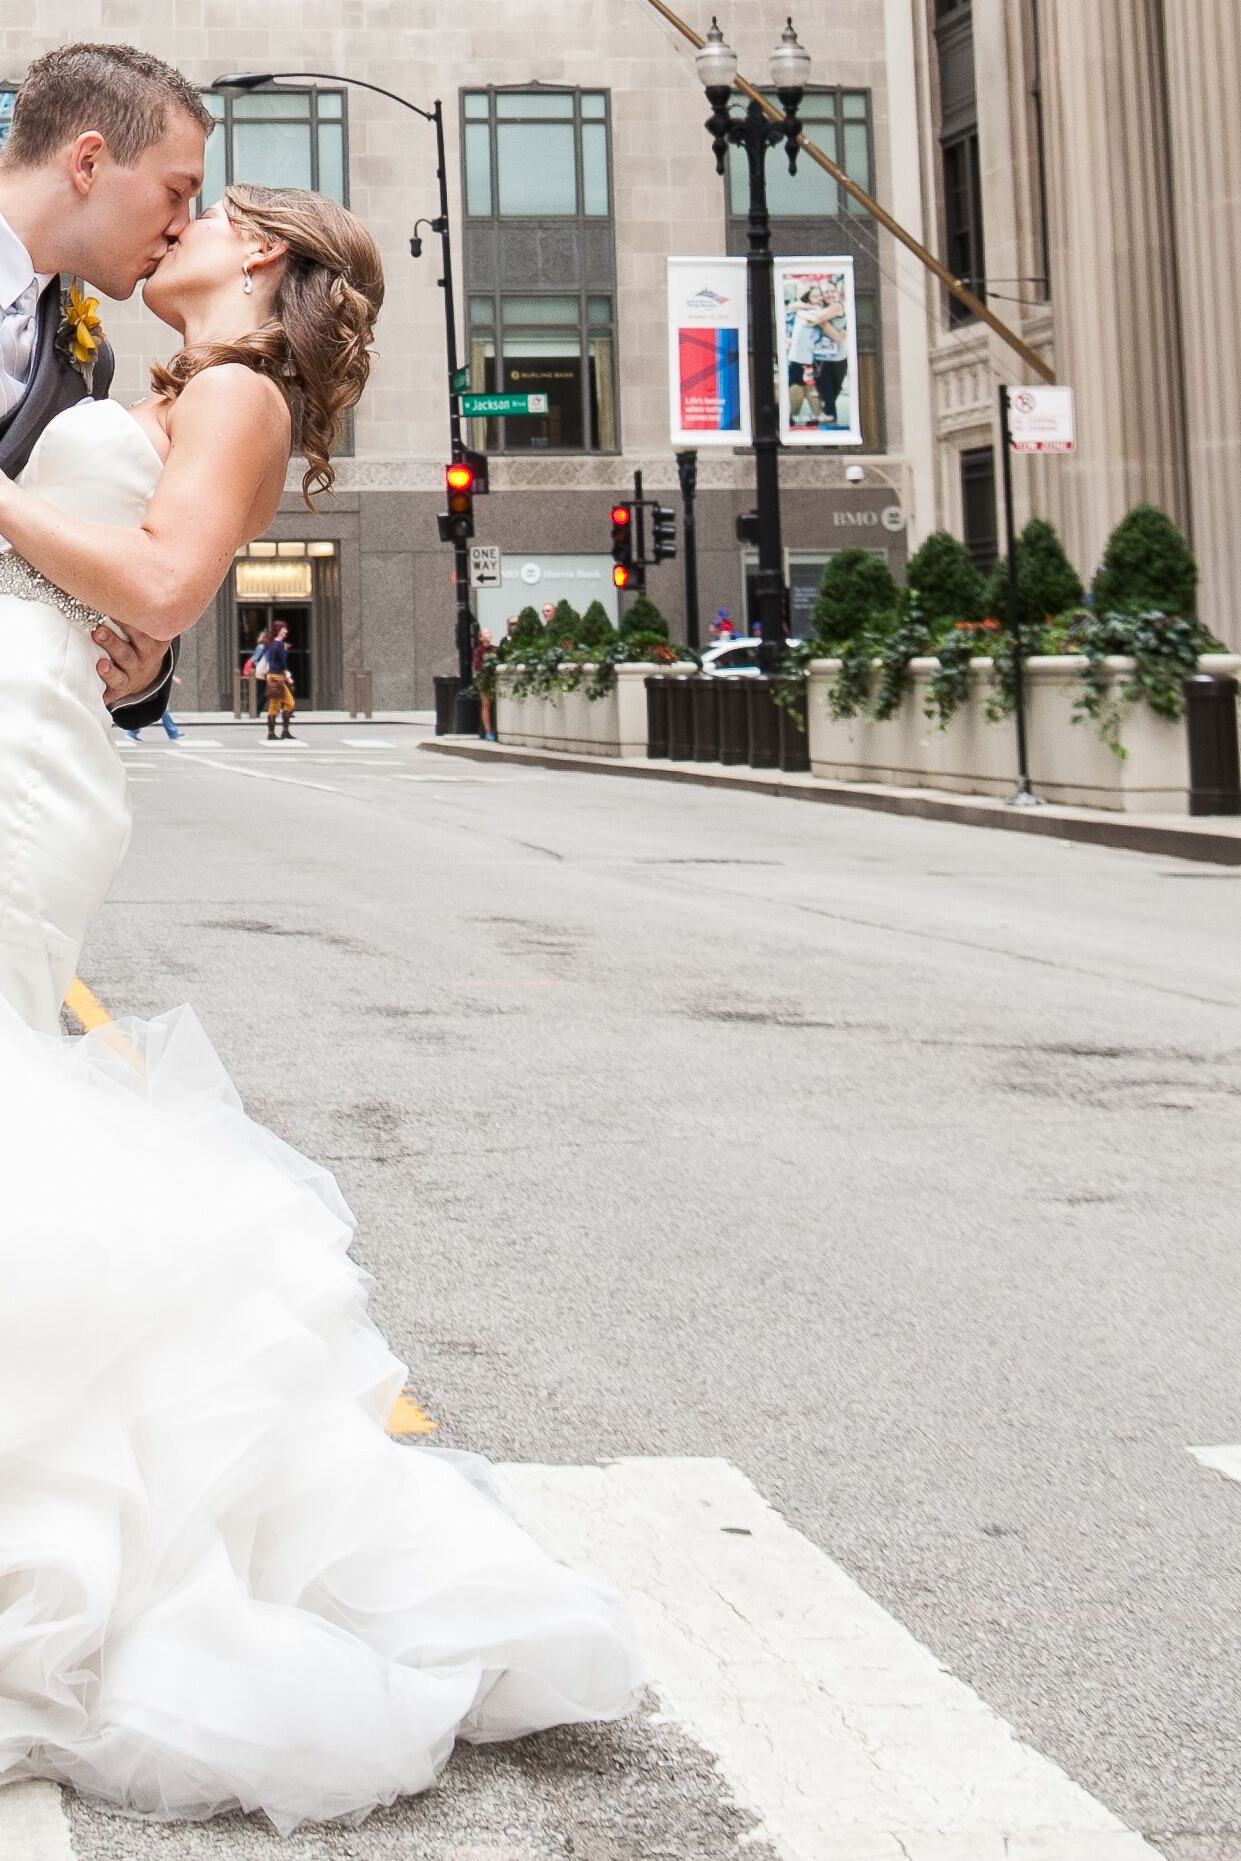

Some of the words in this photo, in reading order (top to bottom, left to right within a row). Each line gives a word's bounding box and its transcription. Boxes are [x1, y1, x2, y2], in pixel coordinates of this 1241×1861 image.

[472, 399, 510, 412] Jackson
[833, 511, 878, 527] BMO
[472, 548, 497, 559] ONE
[473, 561, 496, 571] WAY
